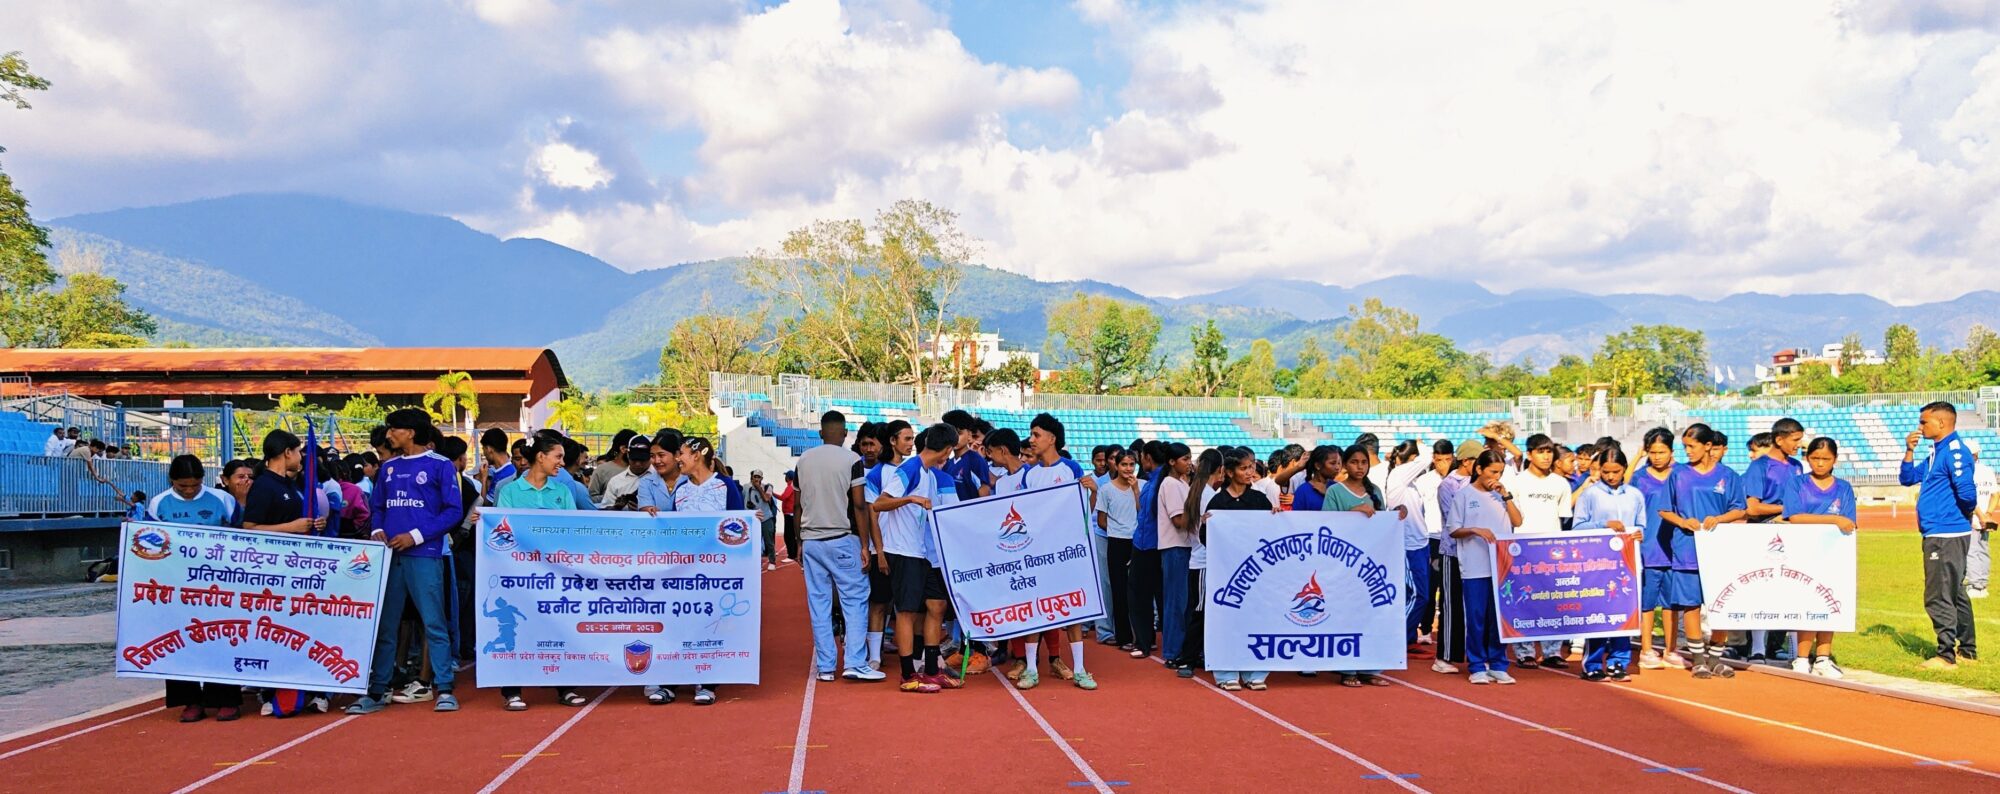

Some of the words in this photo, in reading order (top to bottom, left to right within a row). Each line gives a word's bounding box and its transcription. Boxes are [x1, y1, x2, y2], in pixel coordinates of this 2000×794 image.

[387, 497, 425, 508] Emirates
[397, 490, 407, 498] Fly
[179, 545, 198, 559] १०
[230, 547, 280, 569] राष्ट्रिय
[285, 551, 340, 575] खेलकुद
[545, 550, 585, 567] राष्ट्रिय
[589, 551, 634, 567] खेलकुद
[637, 550, 695, 566] प्रतियोगिता
[952, 567, 983, 584] जिल्ला
[986, 560, 1023, 576] खेलकुद
[1024, 555, 1056, 570] विकास
[1057, 544, 1088, 563] समिति
[1213, 555, 1264, 610] जिल्ला
[1256, 532, 1314, 567] खेलकुद
[1317, 526, 1365, 568] विकास
[1357, 556, 1397, 609] समिति
[187, 564, 285, 588] प्रतियोगिताका
[291, 573, 326, 591] लागि
[500, 572, 556, 591] कर्णाली
[562, 574, 599, 593] प्रदेश
[605, 574, 656, 592] स्तरीय
[661, 573, 745, 592] ब्याडमिण्टन
[1009, 576, 1038, 592] दैलेख
[133, 579, 176, 605] प्रदेश
[180, 585, 236, 609] स्तरीय
[289, 593, 375, 620] प्रतियोगिता
[1708, 583, 1737, 614] जिल्ला
[1737, 567, 1775, 583] खेलकुद
[1781, 564, 1814, 586] विकास
[1816, 583, 1842, 615] समिति
[537, 596, 583, 615] छनौट
[588, 597, 667, 616] प्रतियोगिता
[672, 601, 714, 618] २०८३
[970, 601, 1034, 634] फुटबल
[1807, 611, 1830, 621] जिल्ला
[1513, 618, 1536, 629] जिल्ला
[1563, 615, 1585, 626] विकास
[123, 630, 186, 670] जिल्ला
[185, 618, 252, 647] खेलकुद
[256, 616, 310, 652] विकास
[307, 640, 362, 685] समिति
[537, 640, 566, 648] आयोजक
[1247, 633, 1363, 661] सल्यान
[234, 657, 270, 674] हुम्ला
